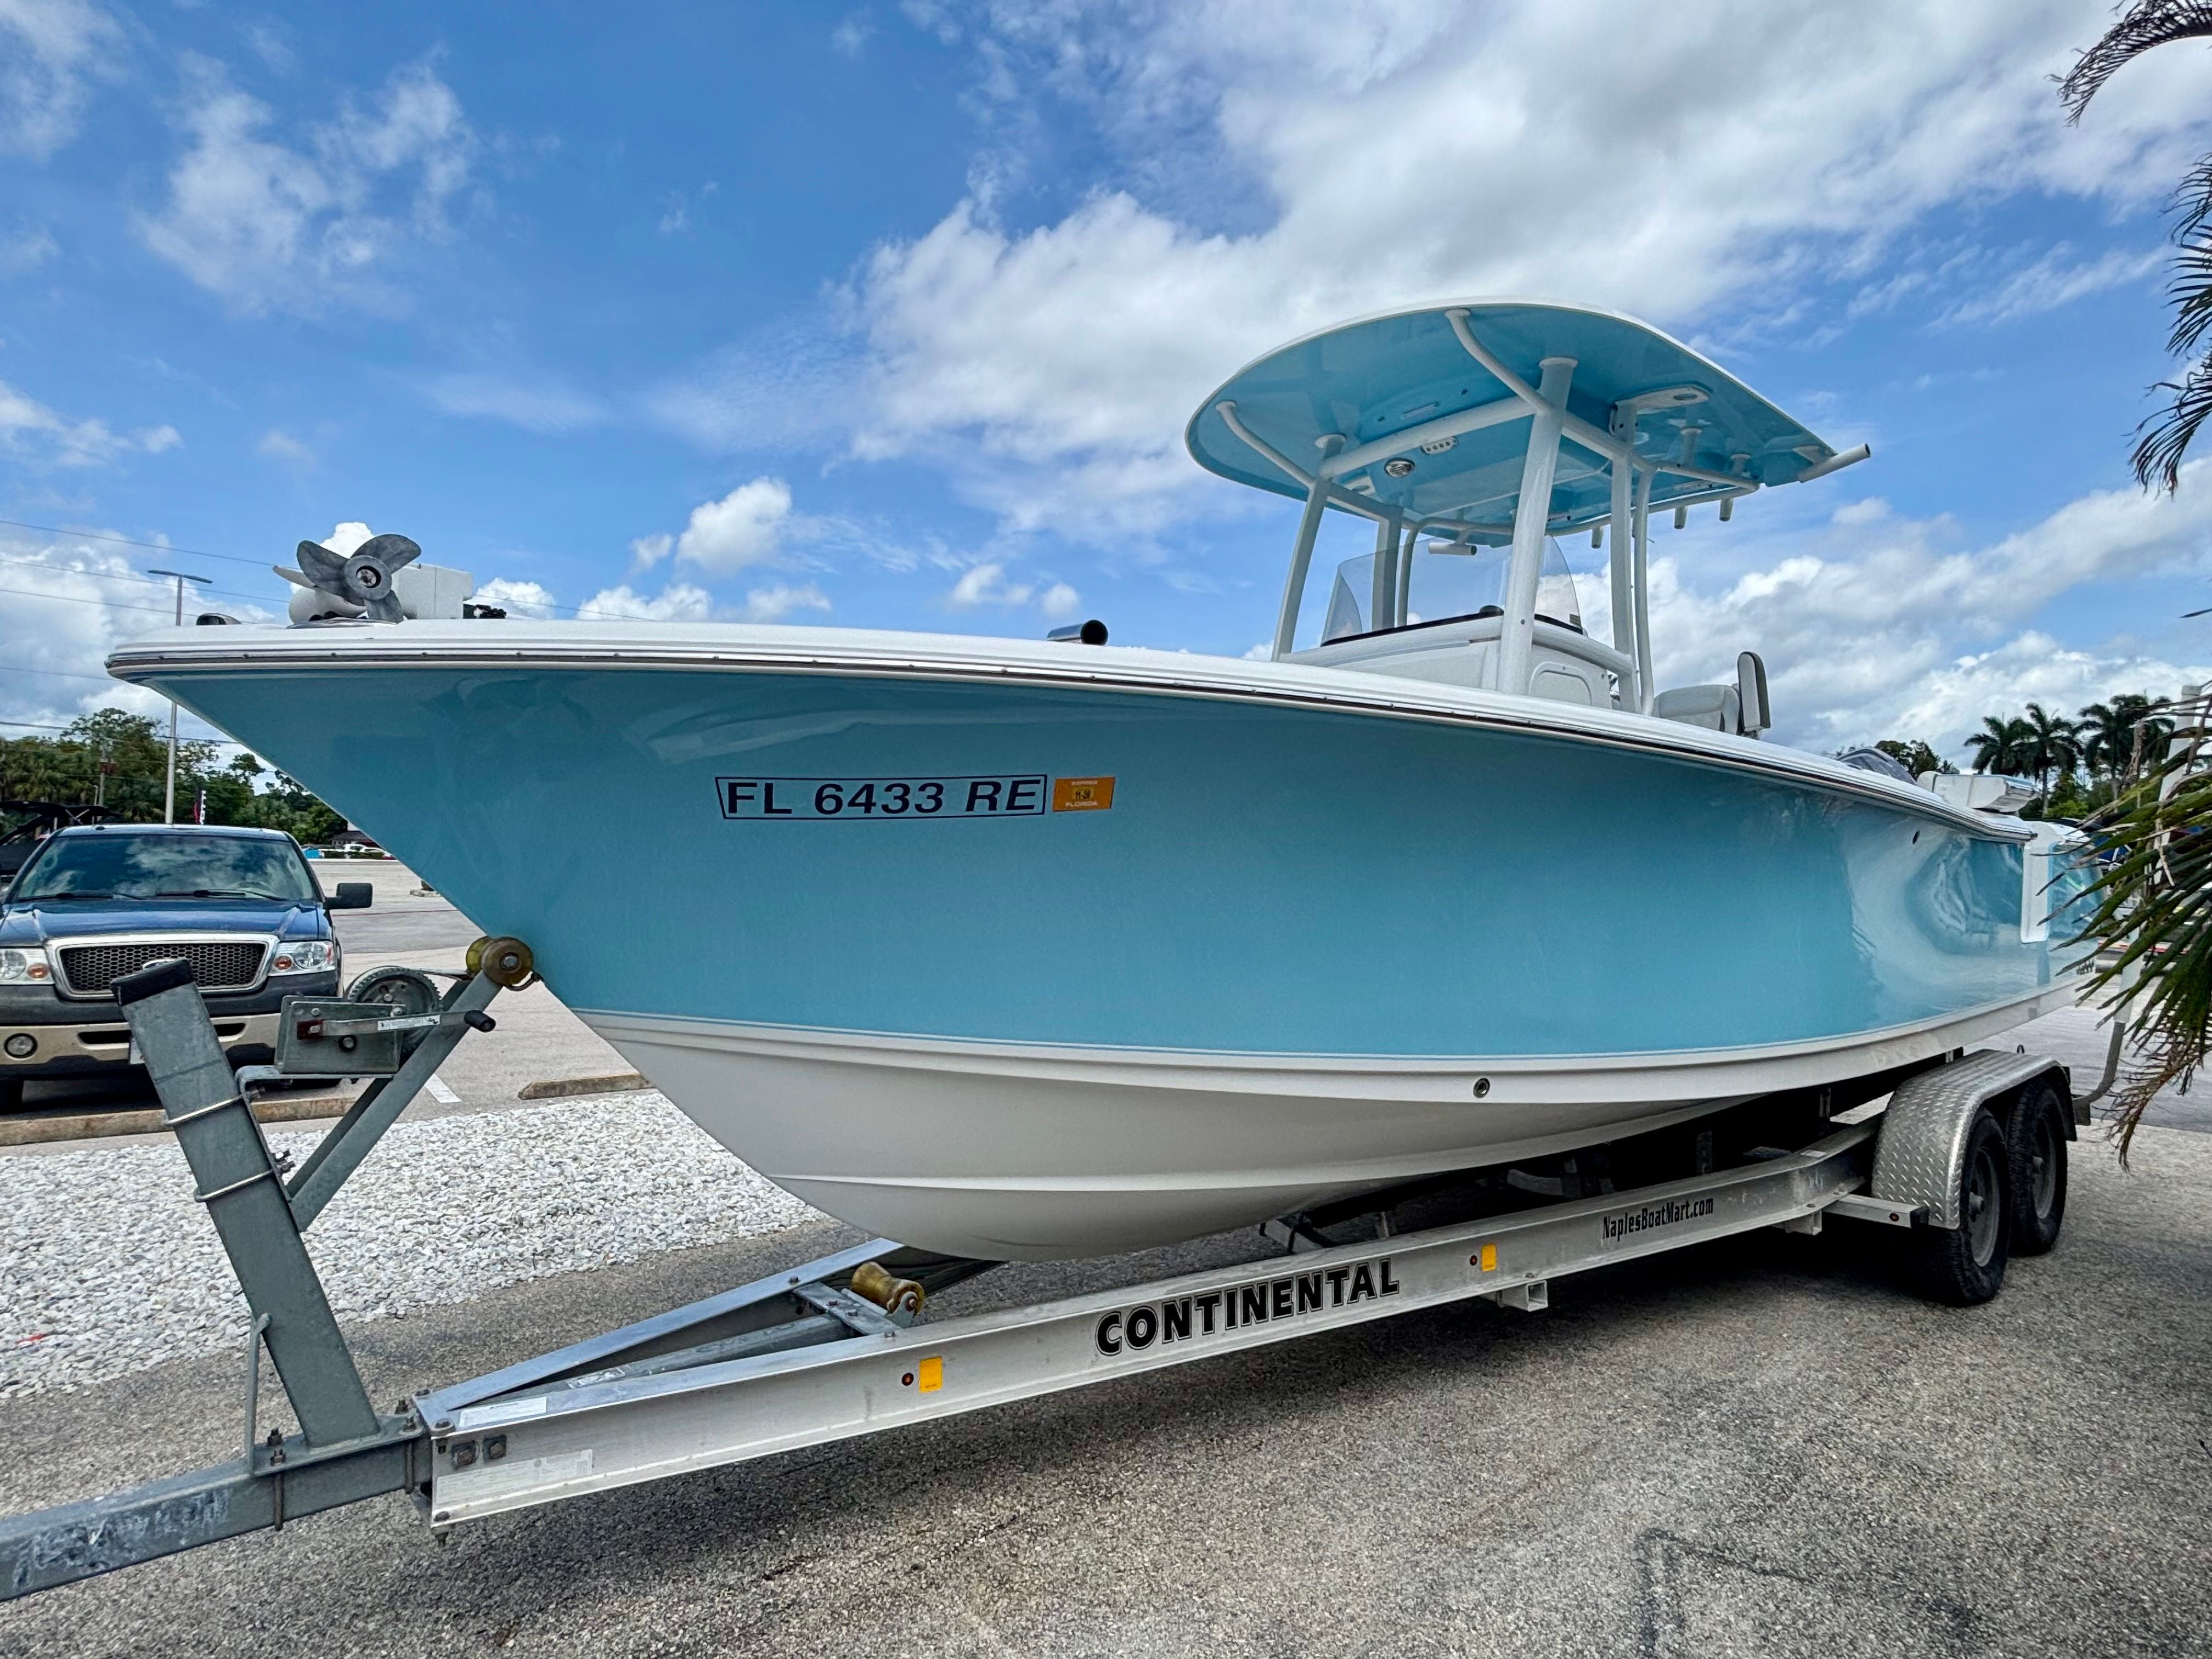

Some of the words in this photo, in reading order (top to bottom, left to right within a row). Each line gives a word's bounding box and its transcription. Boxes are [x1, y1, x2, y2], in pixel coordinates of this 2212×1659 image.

[728, 782, 792, 814] FL
[814, 782, 944, 814] 6433
[965, 779, 1041, 812] RE
[1603, 1198, 1713, 1241] NaplesBoatMart.com
[1096, 1259, 1399, 1355] CONTINENTAL
